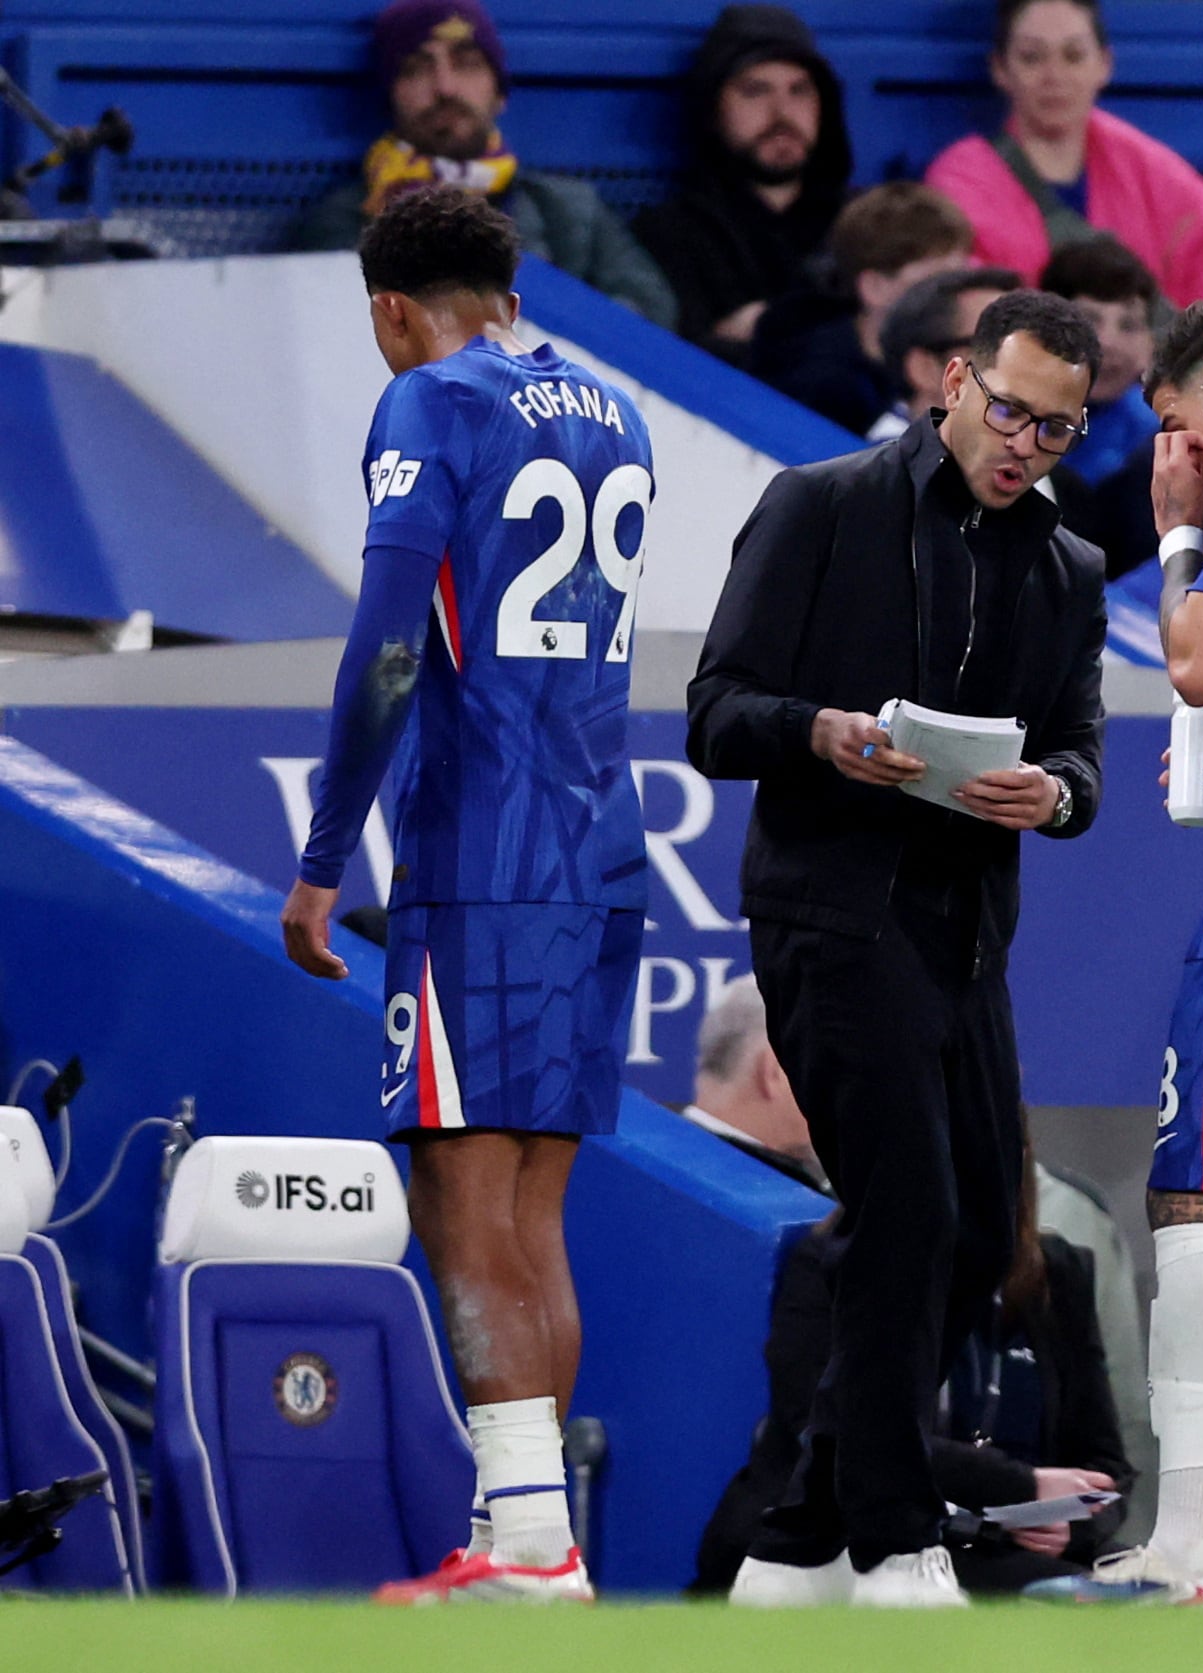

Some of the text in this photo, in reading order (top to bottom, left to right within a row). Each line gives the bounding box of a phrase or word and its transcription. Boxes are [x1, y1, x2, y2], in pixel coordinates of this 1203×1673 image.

[510, 381, 625, 435] FOFANA
[496, 457, 652, 662] 29
[381, 991, 418, 1079] 9
[275, 1172, 375, 1212] IFS.ai
